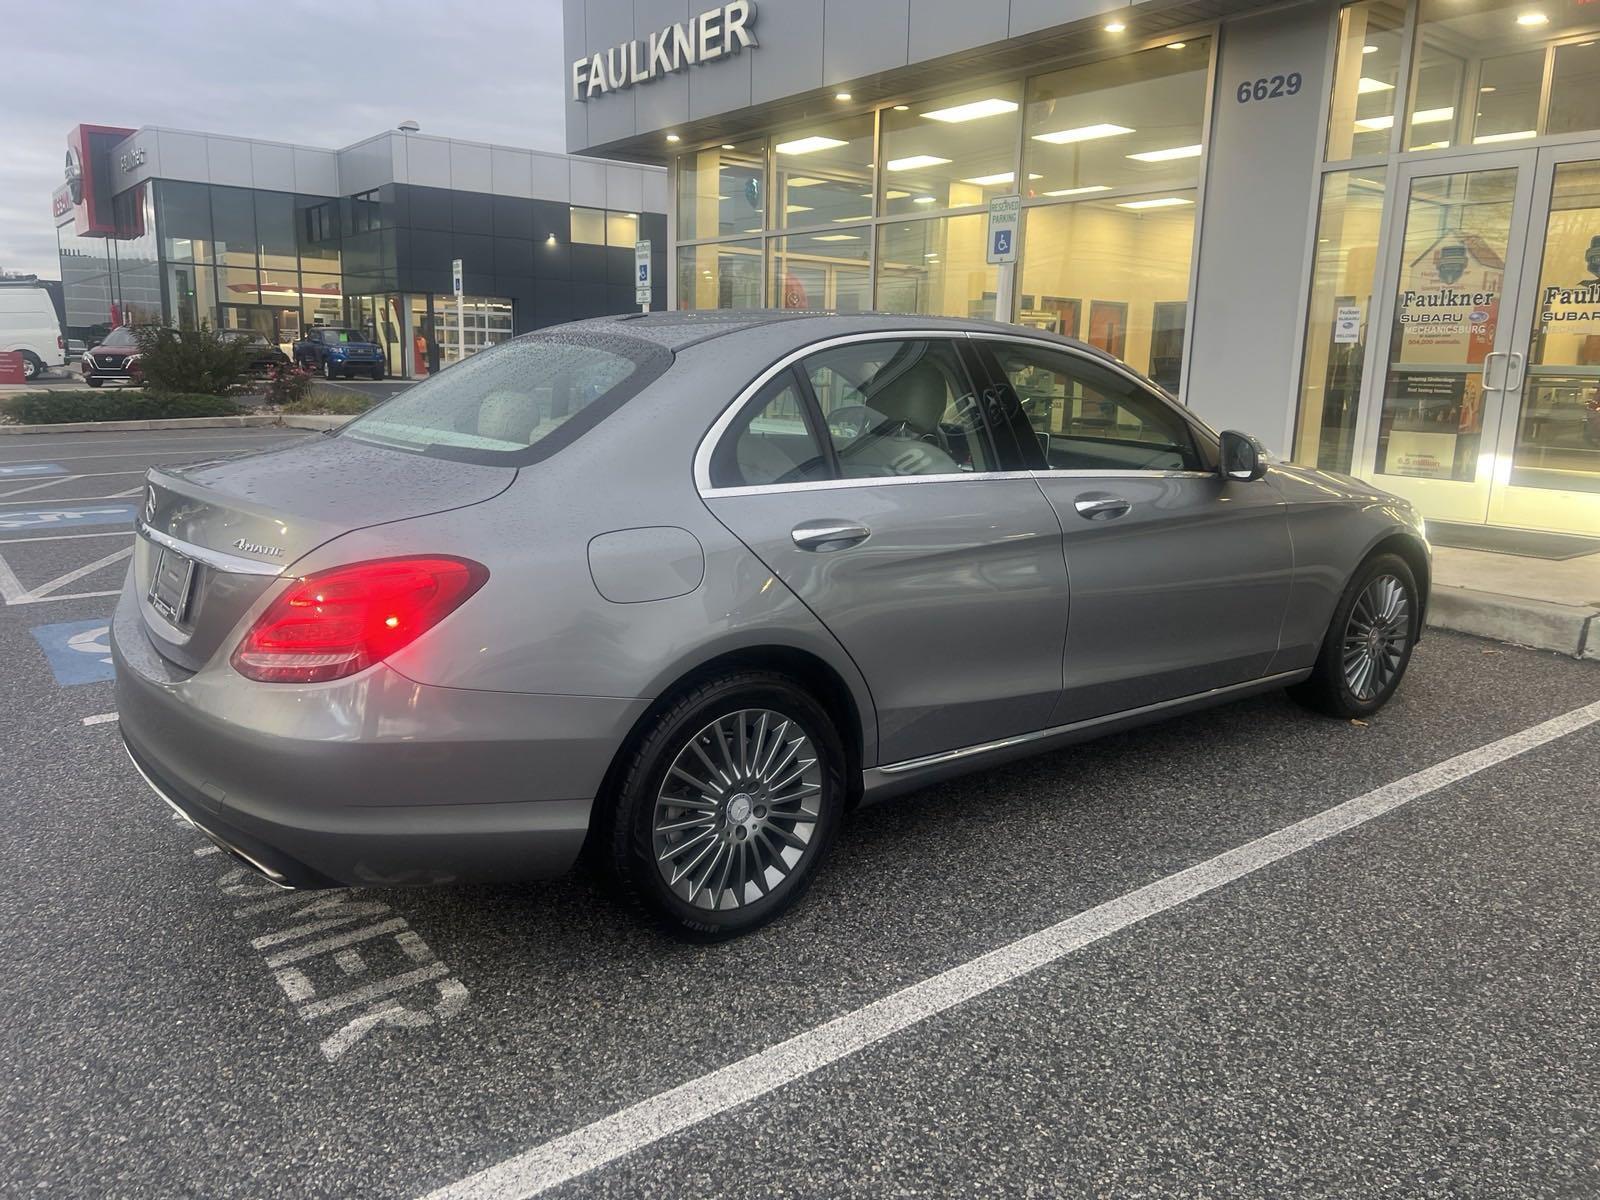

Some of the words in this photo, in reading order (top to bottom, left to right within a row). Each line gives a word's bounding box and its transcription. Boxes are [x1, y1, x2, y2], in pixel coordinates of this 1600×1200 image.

[572, 0, 759, 101] FAULKNER
[1237, 72, 1302, 104] 6629
[991, 200, 1019, 212] RESERVED
[992, 213, 1016, 224] PARKING
[1402, 289, 1494, 308] Faulkner
[1400, 313, 1463, 323] SUBARU
[1405, 324, 1486, 335] MECHANICSBURG
